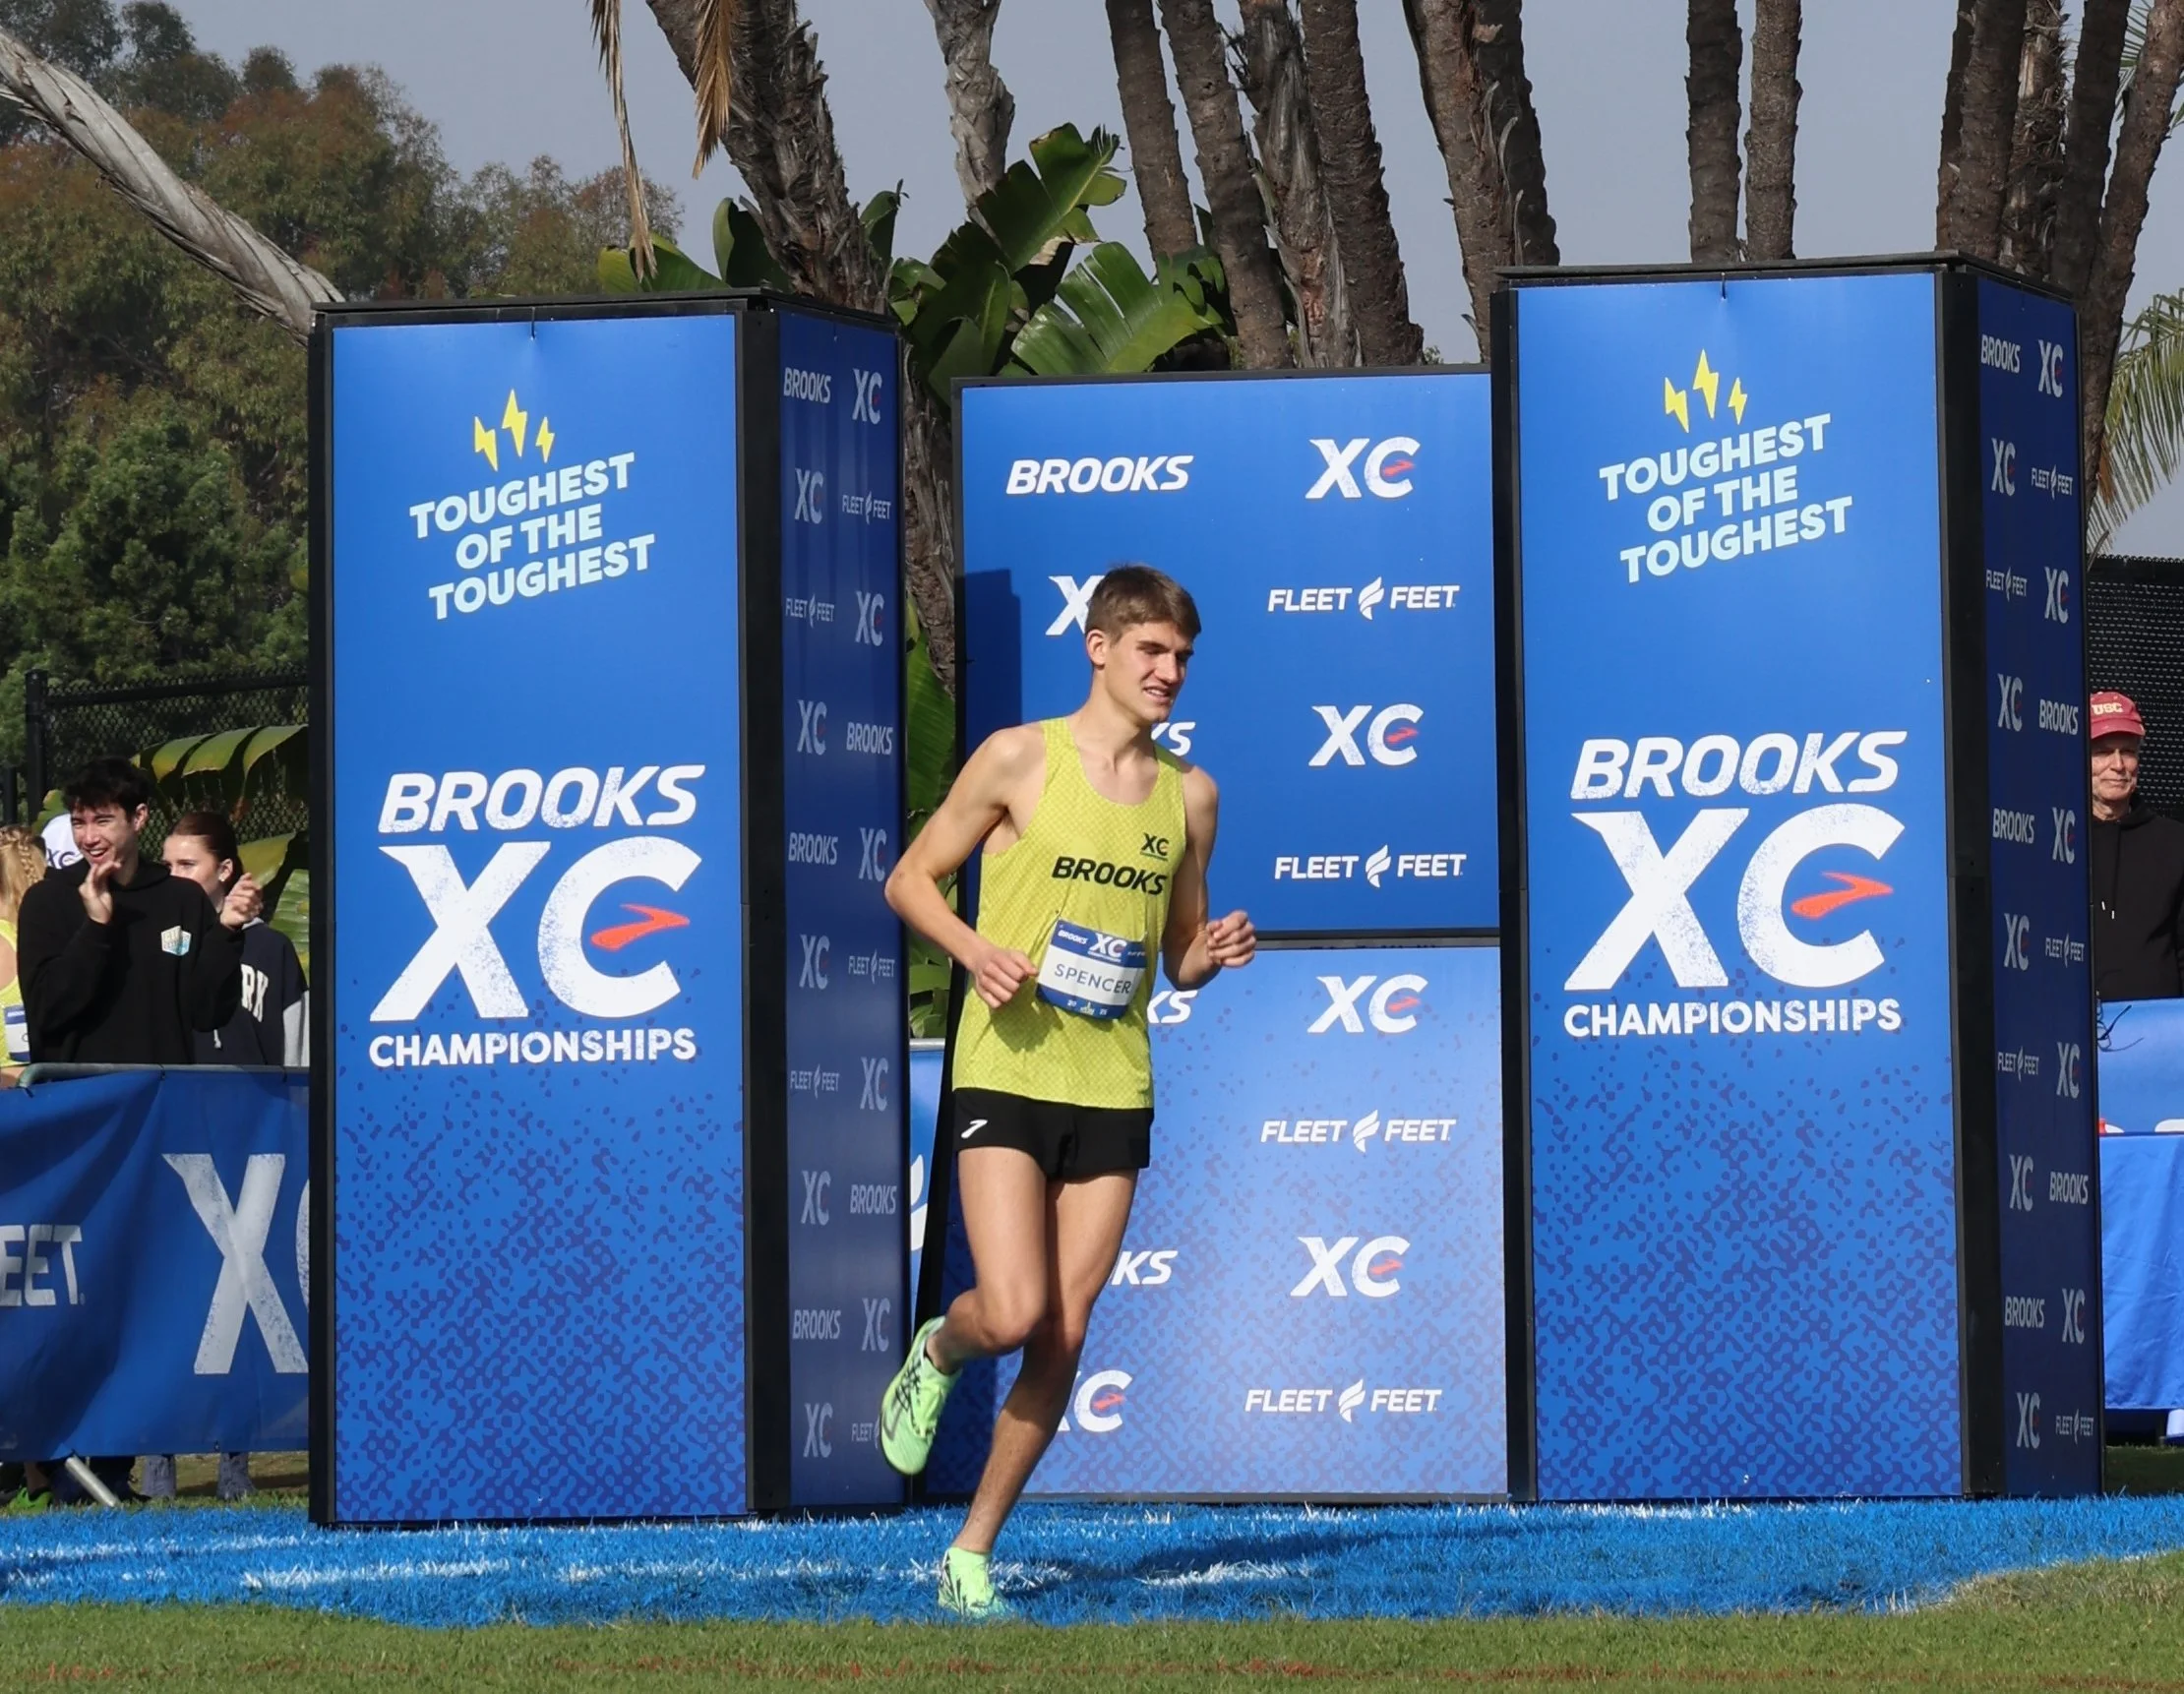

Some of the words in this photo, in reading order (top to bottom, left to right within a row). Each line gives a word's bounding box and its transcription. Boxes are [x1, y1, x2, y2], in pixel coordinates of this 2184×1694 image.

[1981, 334, 2020, 373] BROOKS
[2038, 340, 2063, 397] XC
[784, 368, 831, 403] BROOKS
[852, 369, 881, 424] XC
[1006, 455, 1193, 494] BROOKS
[1305, 437, 1420, 498] XC
[1599, 413, 1831, 501] TOUGHEST
[1992, 439, 2015, 496] XC
[2032, 468, 2049, 489] FLEET
[2056, 474, 2073, 495] FEET
[409, 453, 635, 538] TOUGHEST
[795, 469, 823, 523] XC
[842, 495, 864, 514] FLEET
[872, 500, 891, 518] FEET
[1647, 487, 1706, 532] OF
[1714, 465, 1798, 516] THE
[455, 532, 514, 570] OF
[520, 503, 603, 554] THE
[1620, 496, 1853, 583] TOUGHEST
[429, 534, 655, 620] TOUGHEST
[1268, 588, 1353, 611] FLEET
[1390, 585, 1459, 609] FEET
[1986, 570, 2004, 590] FLEET
[2011, 575, 2027, 596] FEET
[2045, 567, 2068, 623] XC
[786, 598, 808, 618] FLEET
[816, 603, 834, 622] FEET
[855, 591, 884, 645] XC
[1045, 575, 1106, 635] X
[797, 700, 826, 756] XC
[1998, 674, 2023, 731] XC
[2039, 699, 2078, 735] BROOKS
[2092, 701, 2123, 715] USC
[846, 722, 893, 755] BROOKS
[1308, 704, 1424, 765] XC
[1571, 731, 1907, 799] BROOKS
[379, 765, 705, 832] BROOKS
[789, 832, 838, 865] BROOKS
[1142, 832, 1169, 856] XC
[1993, 809, 2034, 843] BROOKS
[2052, 808, 2075, 864] XC
[859, 828, 886, 881] XC
[1052, 856, 1168, 895] BROOKS
[1275, 856, 1359, 878] FLEET
[1398, 854, 1466, 877] FEET
[1564, 804, 1905, 990] XC
[370, 836, 701, 1021] XC
[1089, 933, 1127, 958] XC
[2004, 913, 2029, 970] XC
[2045, 938, 2063, 957] FLEET
[2069, 942, 2084, 961] FEET
[799, 935, 829, 990] XC
[849, 956, 870, 975] FLEET
[877, 958, 894, 977] FEET
[1055, 964, 1132, 995] SPENCER
[240, 964, 269, 1022] RK
[1307, 975, 1427, 1033] XC
[1564, 998, 1902, 1037] CHAMPIONSHIPS
[369, 1029, 696, 1068] CHAMPIONSHIPS
[1998, 1052, 2017, 1071] FLEET
[2023, 1056, 2038, 1074] FEET
[2057, 1042, 2080, 1098] XC
[790, 1070, 813, 1089] FLEET
[820, 1072, 839, 1091] FEET
[860, 1058, 888, 1112] XC
[1261, 1120, 1347, 1142] FLEET
[1385, 1119, 1456, 1141] FEET
[801, 1171, 830, 1225] XC
[850, 1184, 896, 1214] BROOKS
[2010, 1155, 2033, 1211] XC
[2050, 1172, 2088, 1204] BROOKS
[0, 1224, 83, 1306] EET
[161, 1153, 309, 1374] X
[1291, 1237, 1410, 1297] XC
[793, 1309, 841, 1339] BROOKS
[862, 1298, 890, 1352] XC
[2005, 1297, 2044, 1327] BROOKS
[2062, 1289, 2085, 1344] XC
[1058, 1369, 1133, 1432] C
[1245, 1390, 1332, 1412] FLEET
[1370, 1389, 1442, 1412] FEET
[2017, 1393, 2040, 1448] XC
[804, 1403, 833, 1457] XC
